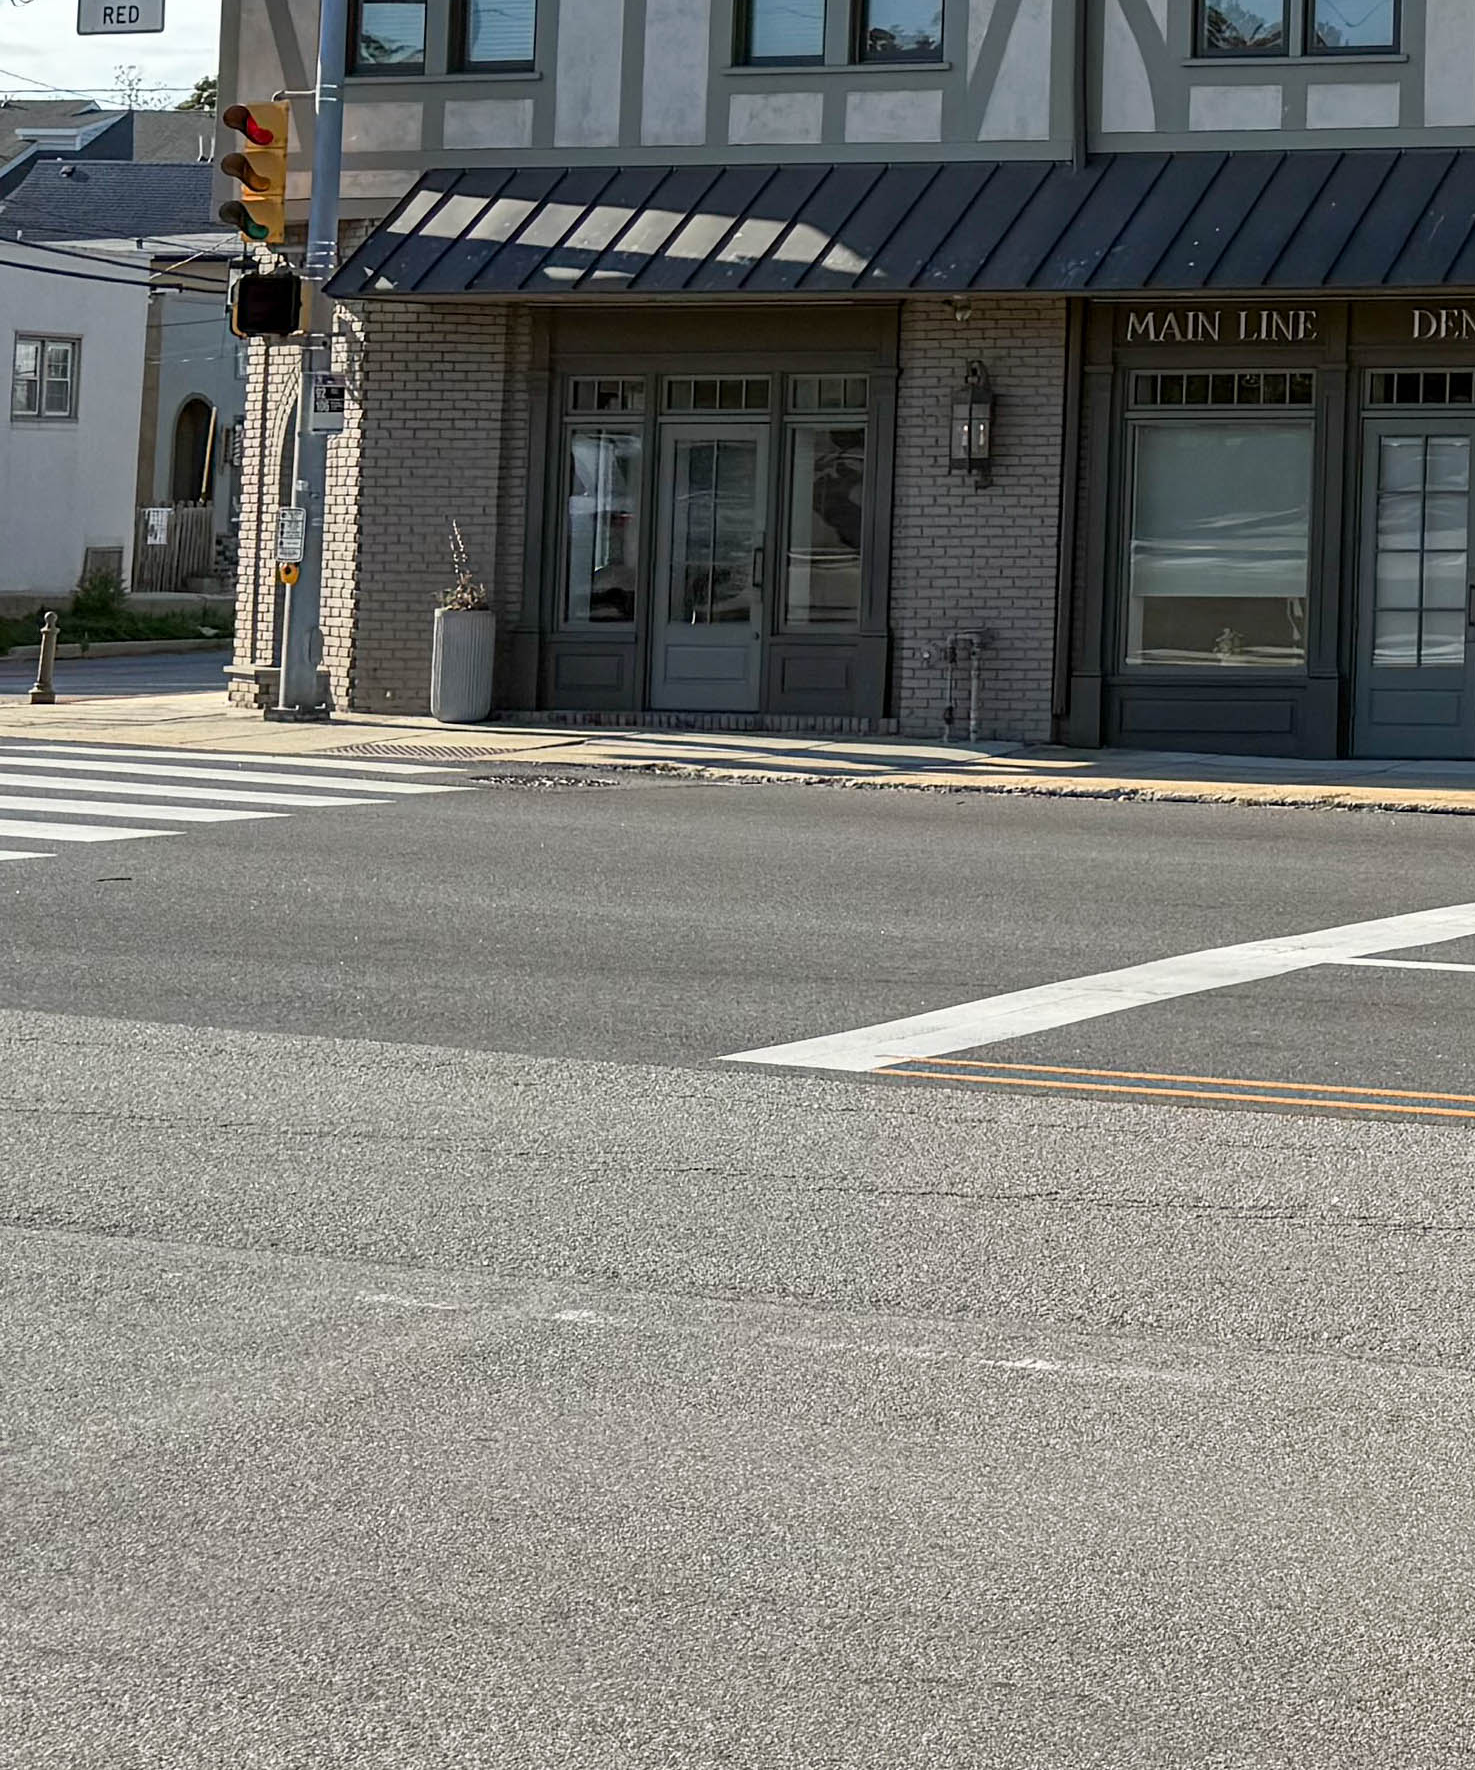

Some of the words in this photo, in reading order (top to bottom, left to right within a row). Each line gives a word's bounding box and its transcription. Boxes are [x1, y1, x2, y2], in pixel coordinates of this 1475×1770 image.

[103, 5, 139, 25] RED
[1127, 311, 1221, 342] MAIN
[1238, 310, 1317, 342] LINE
